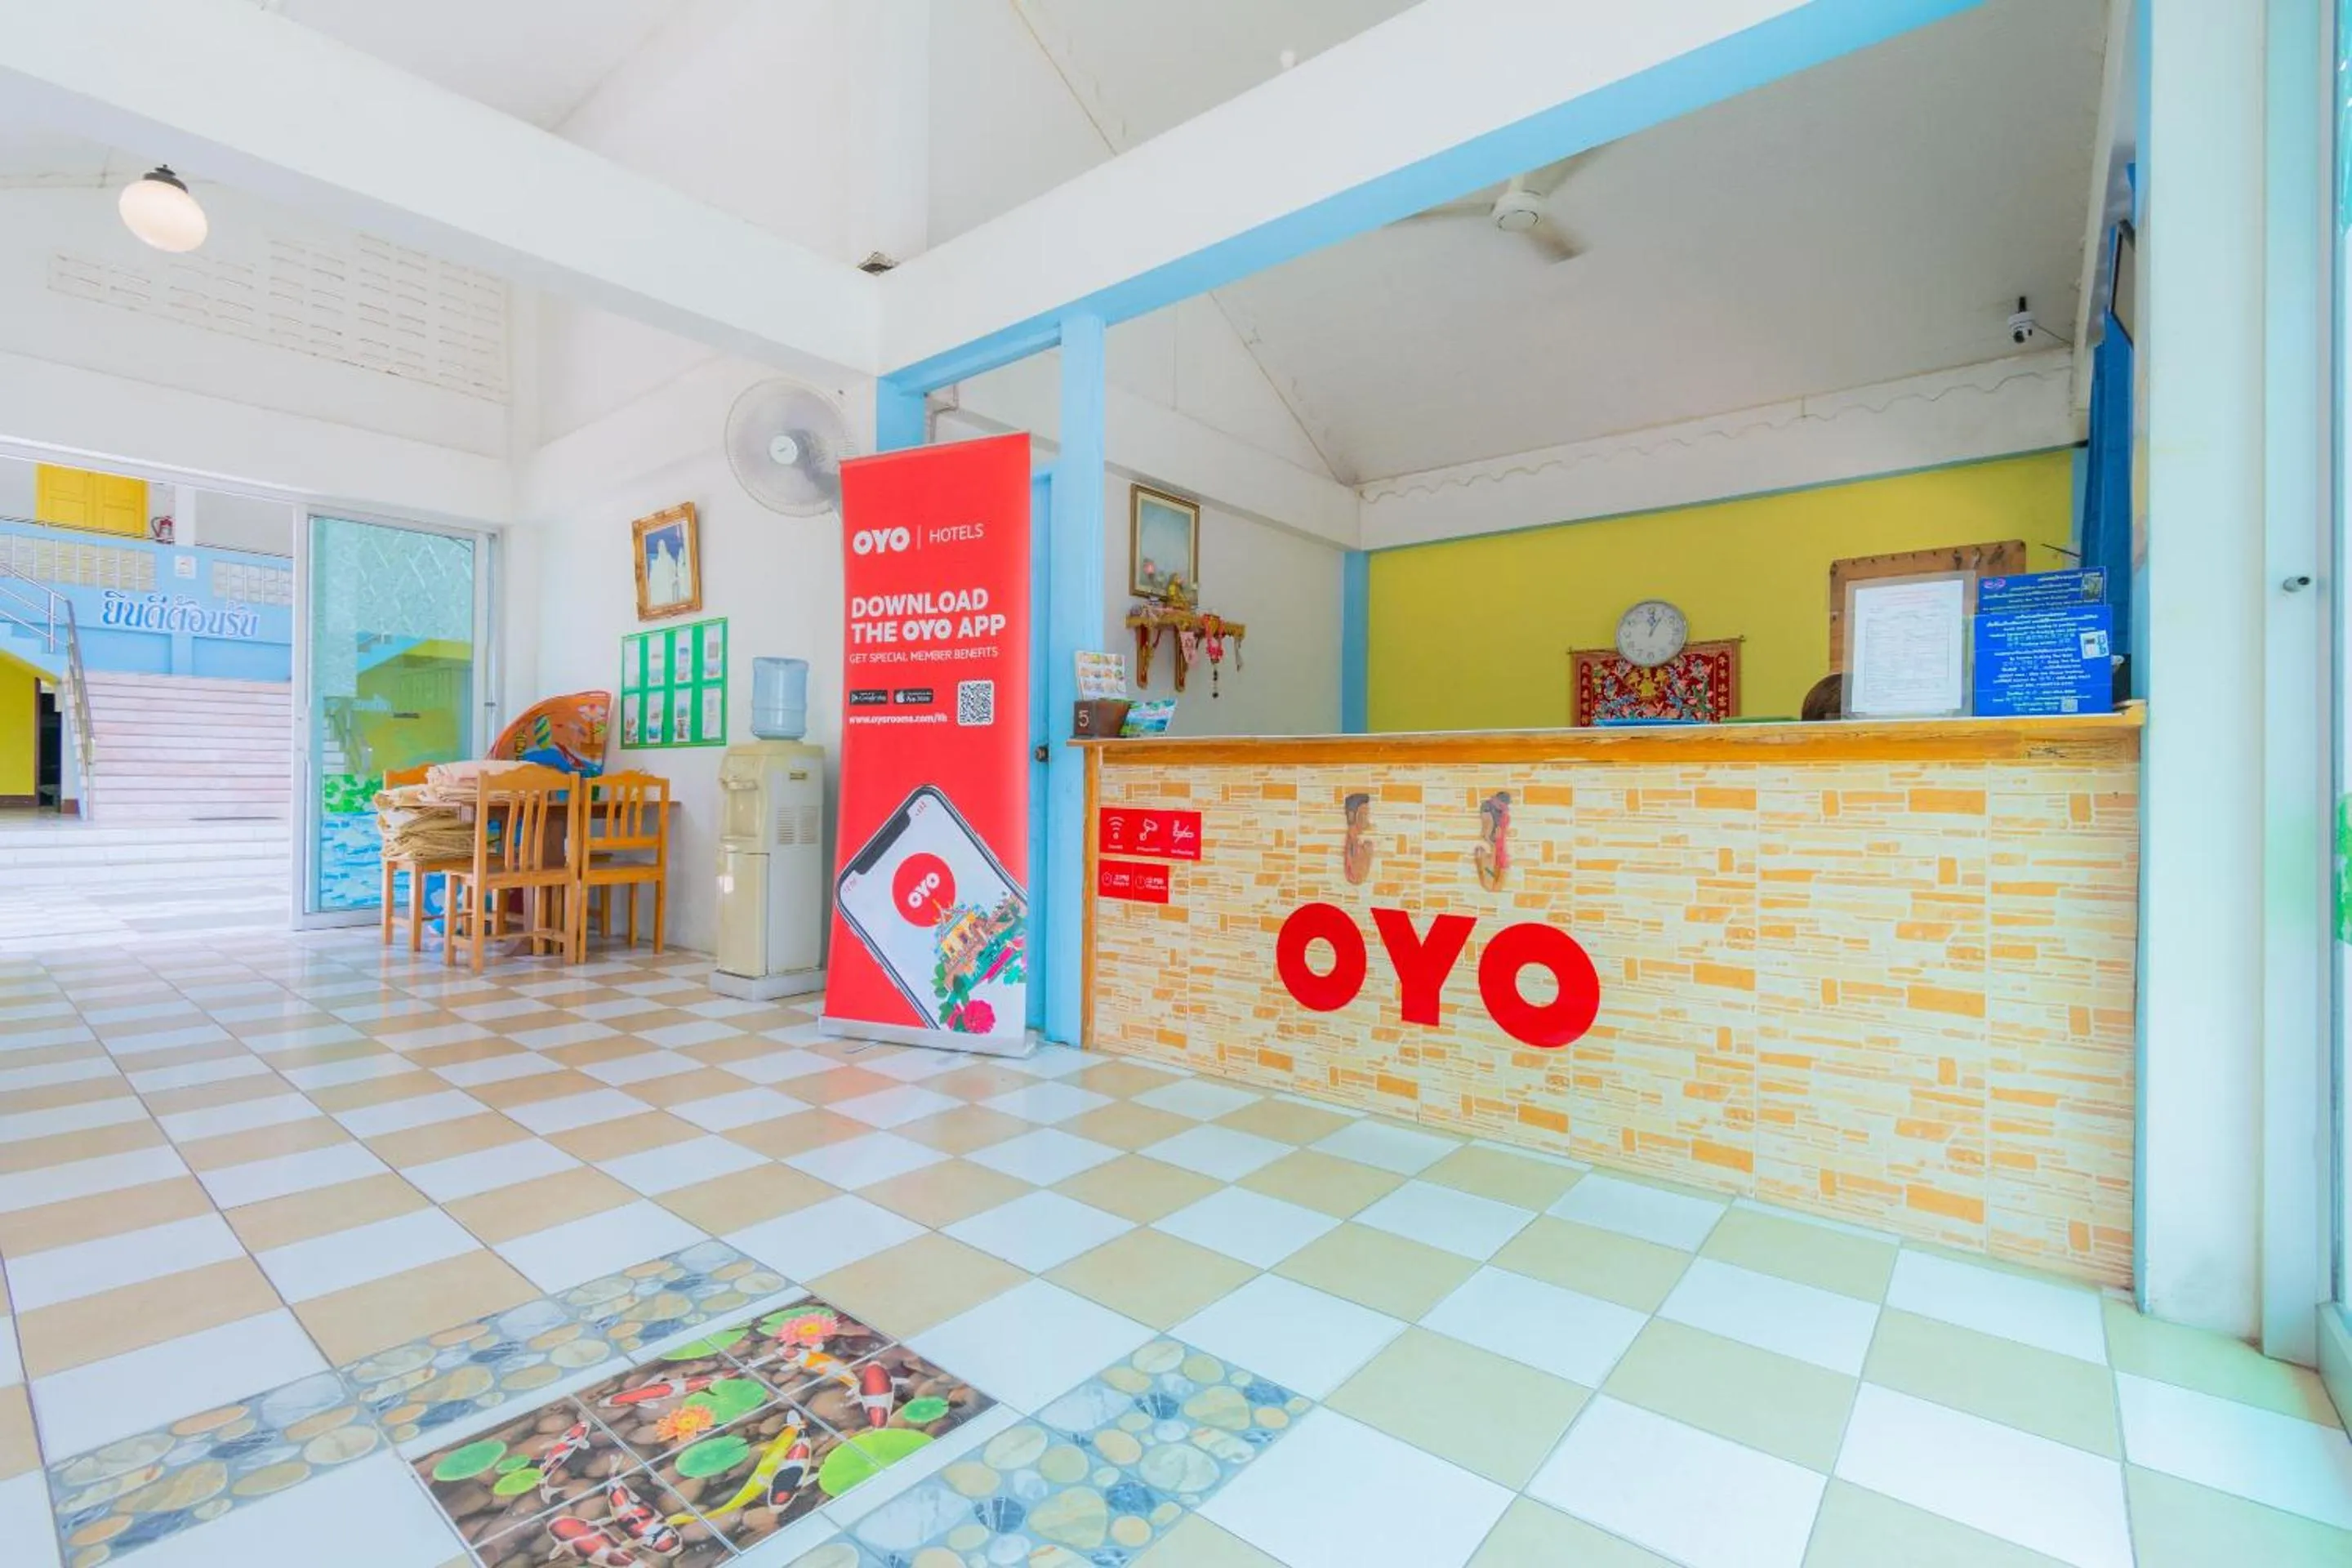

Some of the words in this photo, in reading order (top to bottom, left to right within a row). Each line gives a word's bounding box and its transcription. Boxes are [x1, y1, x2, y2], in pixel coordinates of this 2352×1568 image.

[853, 526, 911, 555] OYO
[929, 523, 984, 543] HOTELS
[102, 590, 259, 638] ยินดีต้อนรับ
[851, 588, 988, 618] DOWNLOAD
[851, 621, 898, 644] THE
[902, 619, 952, 641] OYO
[957, 614, 1006, 639] APP
[849, 653, 866, 664] GET
[869, 652, 907, 663] SPECIAL
[910, 650, 952, 662] MEMBER
[954, 647, 998, 660] BENEFITS
[908, 871, 940, 909] OYO
[1276, 902, 1601, 1049] OYO
